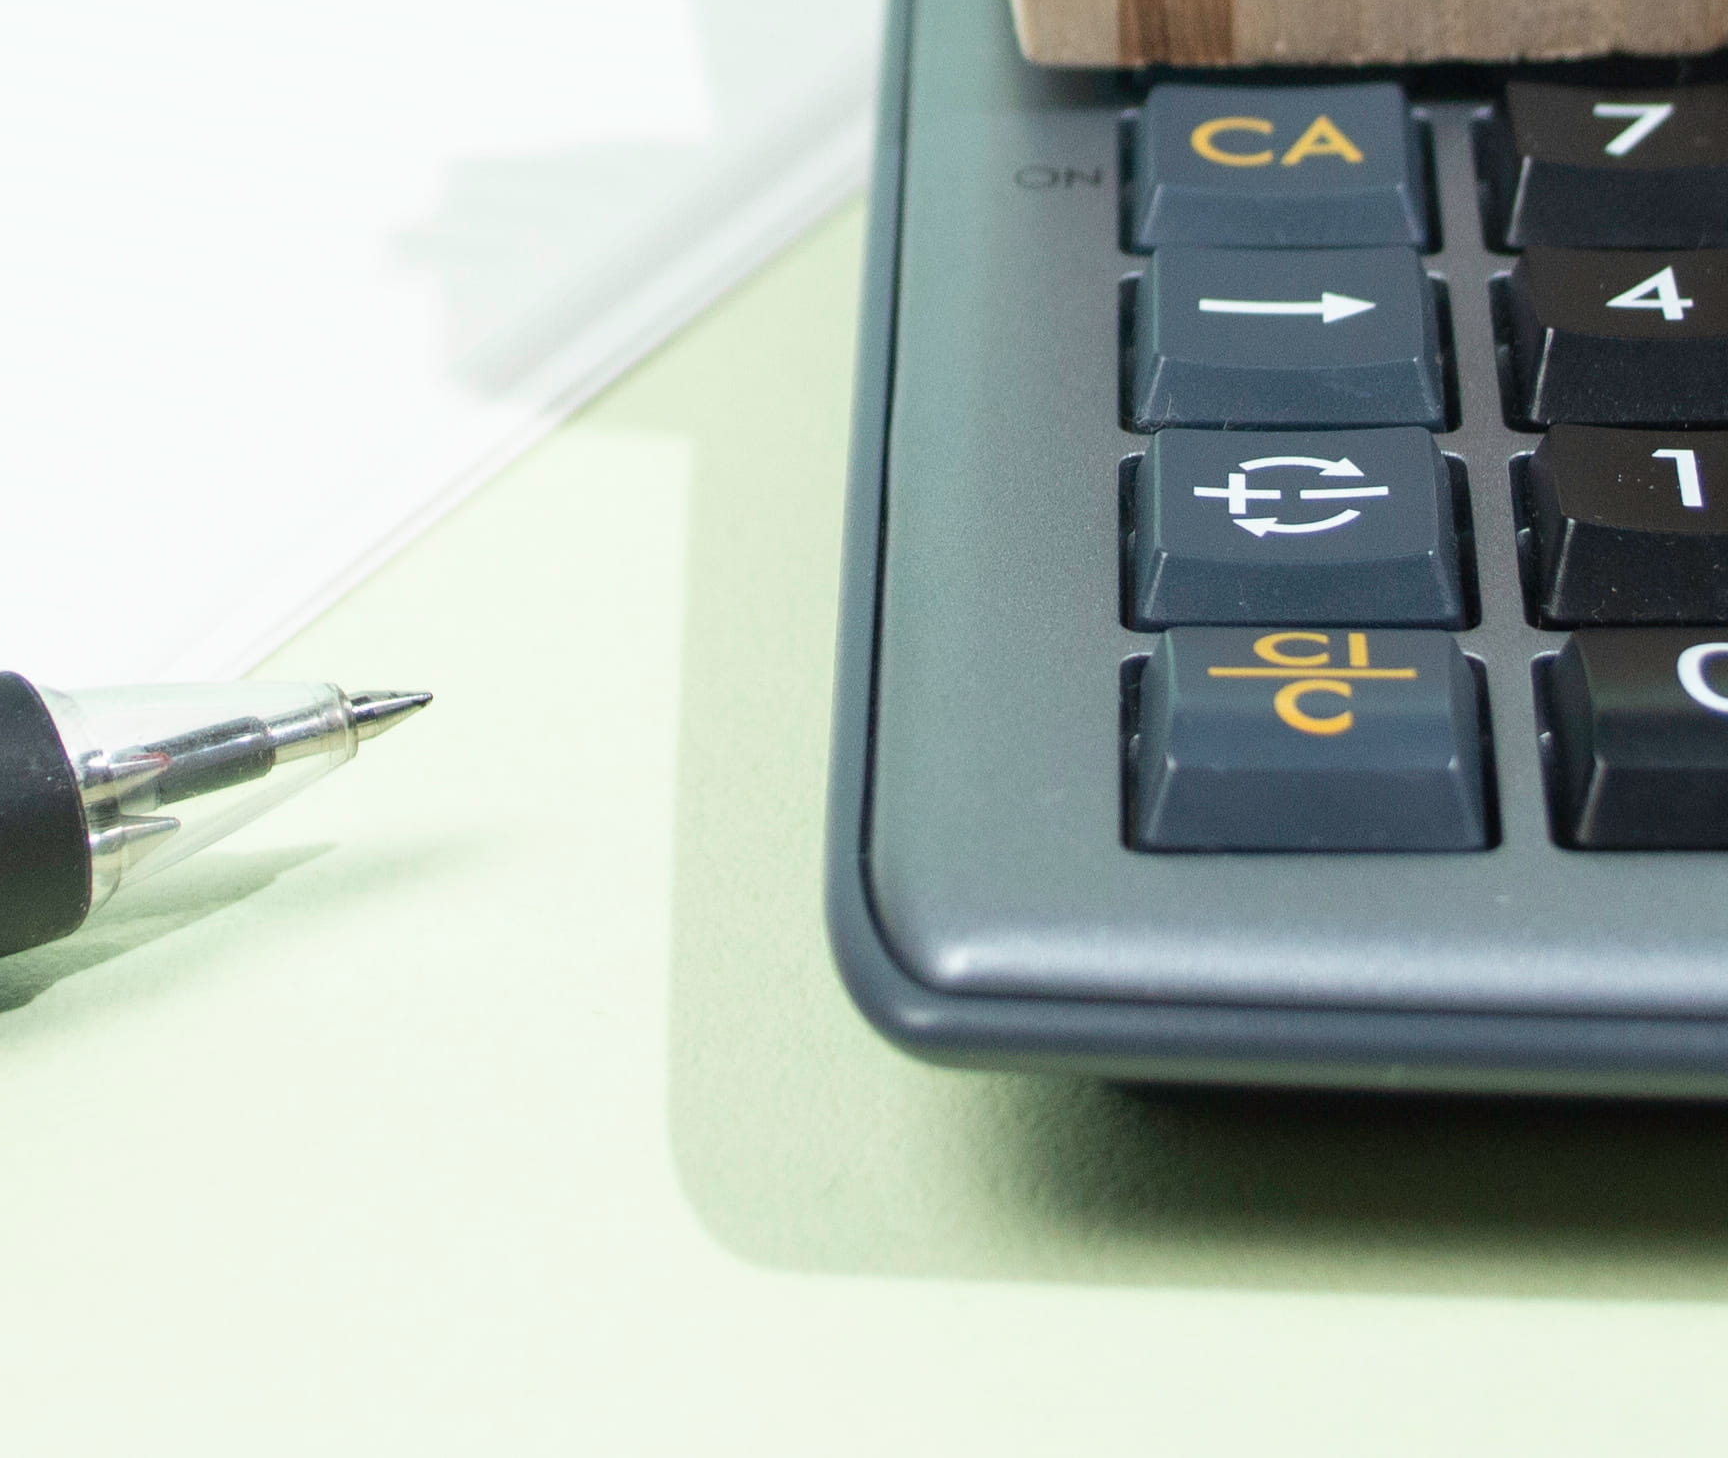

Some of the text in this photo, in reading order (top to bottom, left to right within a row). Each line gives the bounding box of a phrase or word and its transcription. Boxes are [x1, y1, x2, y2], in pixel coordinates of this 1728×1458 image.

[1190, 115, 1364, 167] CA
[1593, 103, 1674, 156] 7
[1014, 162, 1103, 190] ON
[1605, 265, 1695, 322] 4
[1650, 447, 1704, 509] 1
[1274, 677, 1353, 736] C
